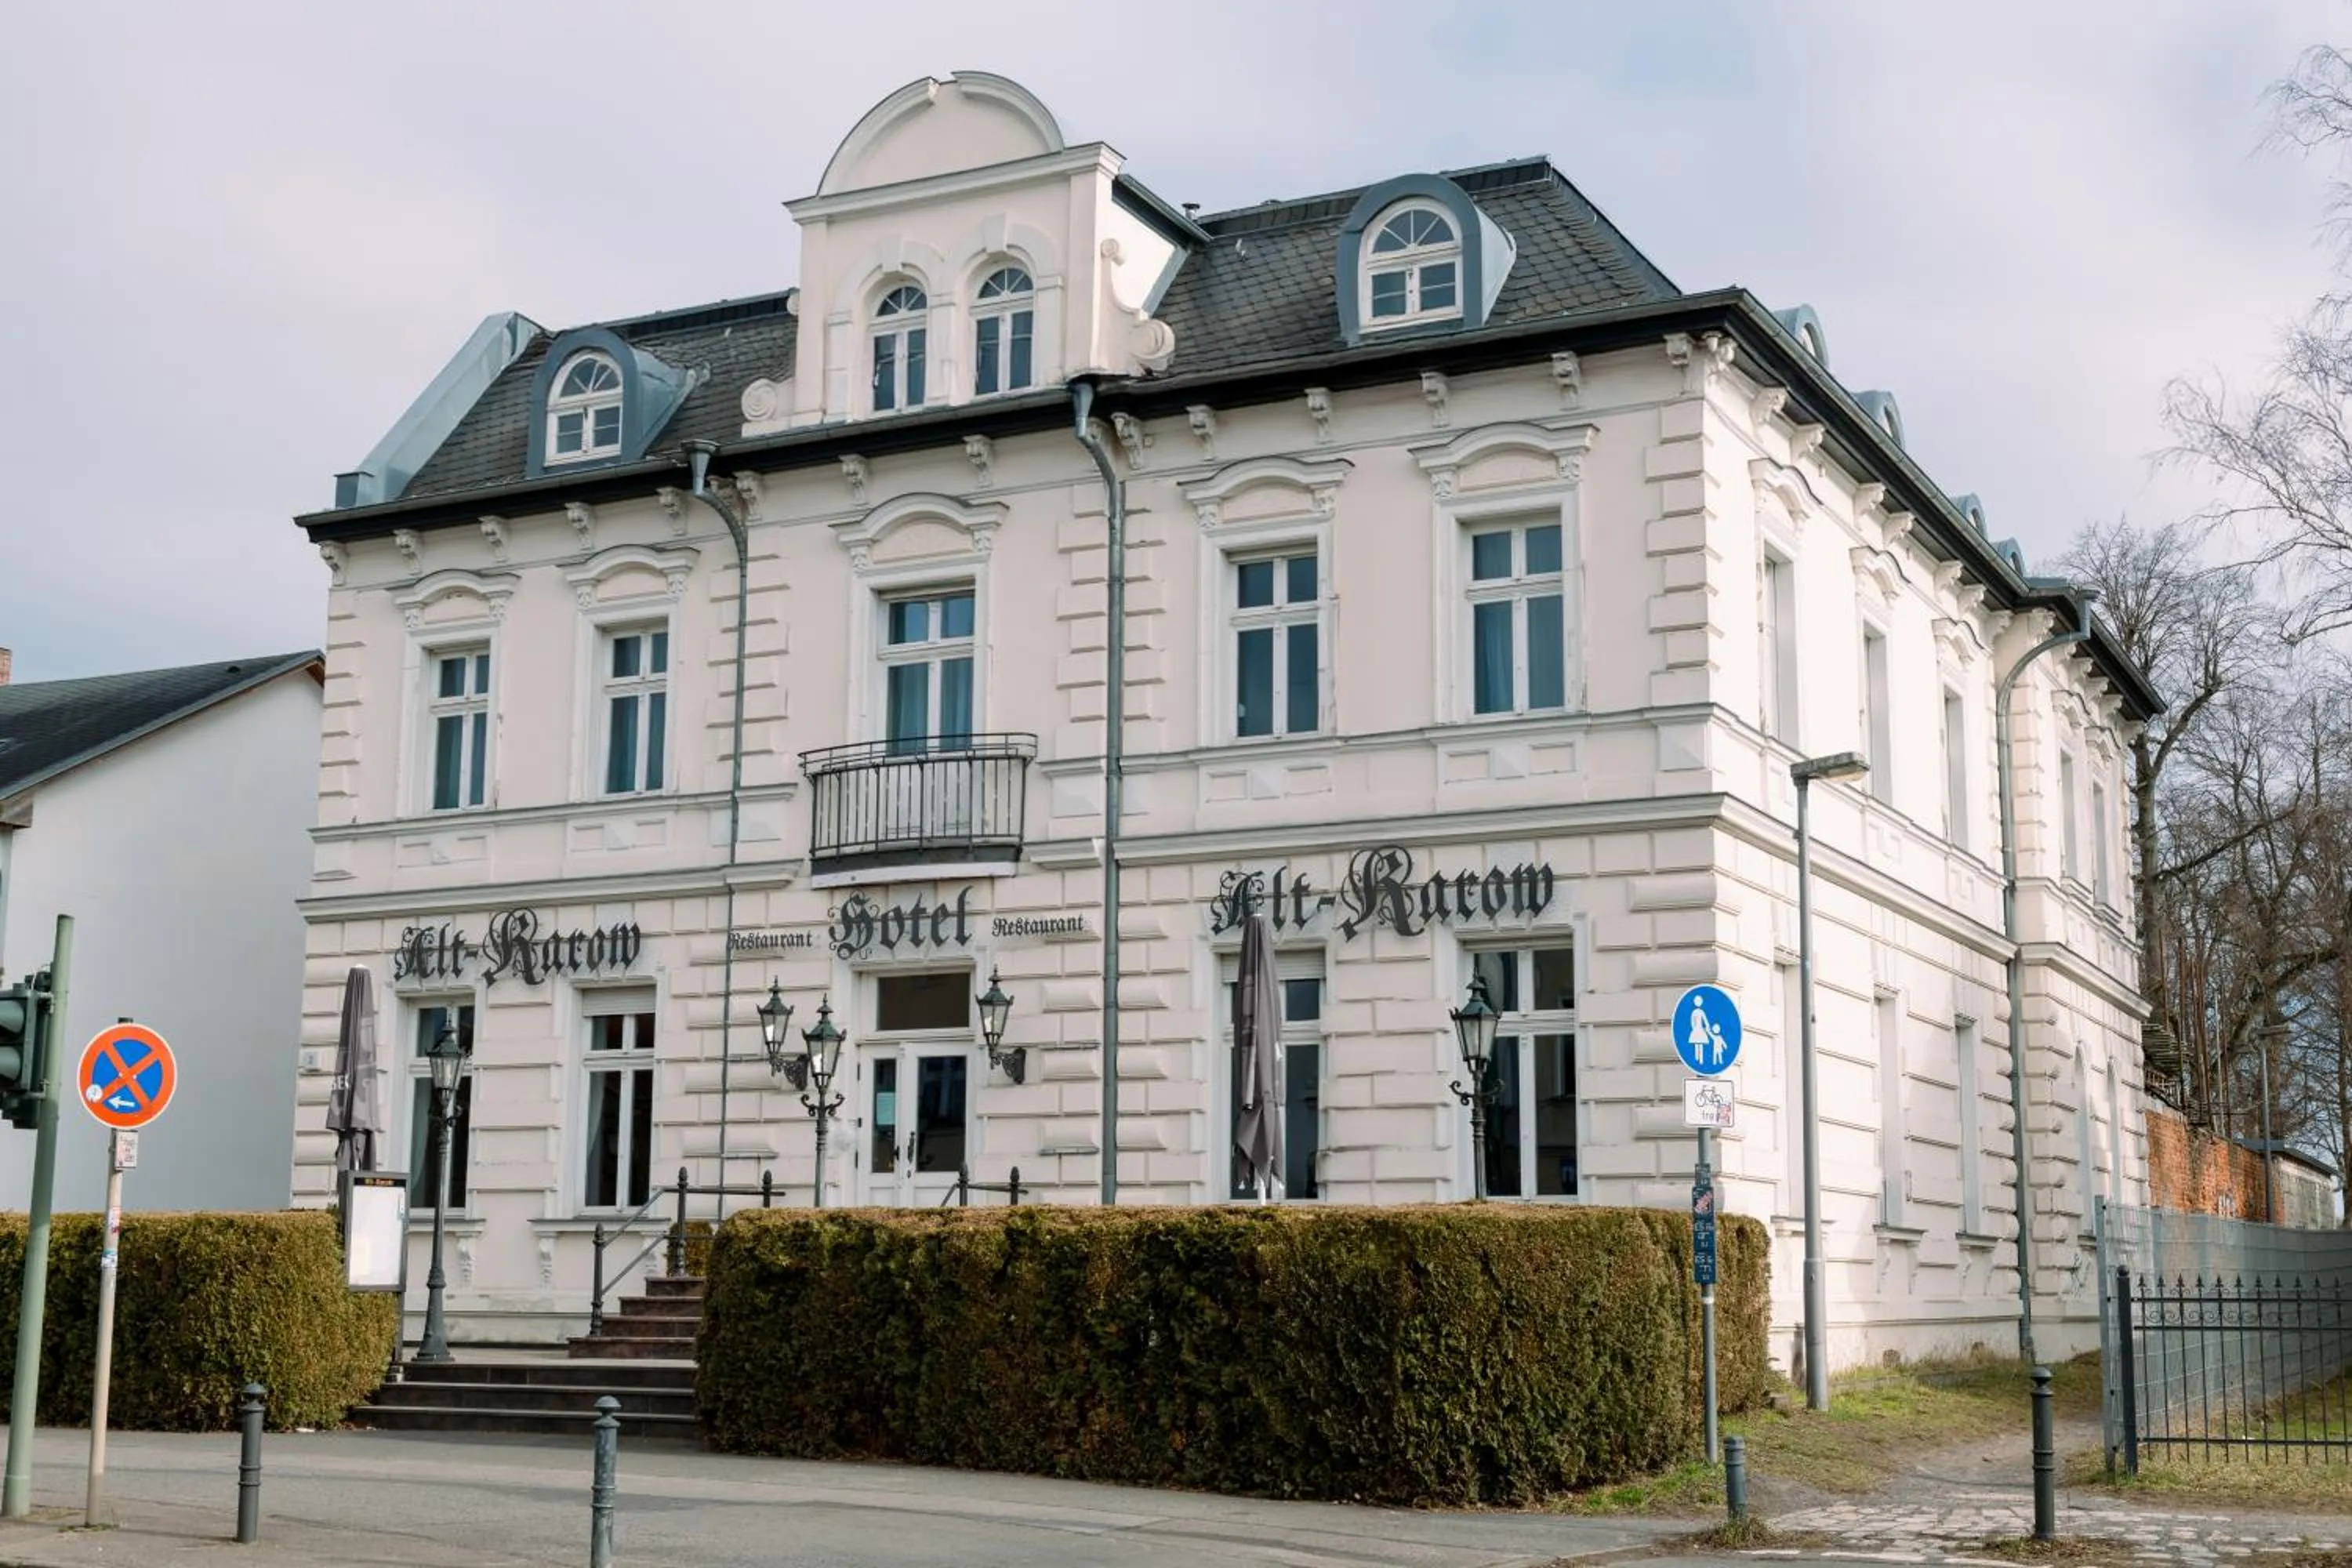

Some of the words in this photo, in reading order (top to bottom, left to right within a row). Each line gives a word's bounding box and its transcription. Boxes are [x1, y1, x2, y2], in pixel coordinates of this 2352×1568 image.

[828, 885, 974, 960] Hotel
[992, 913, 1083, 937] Restaurant
[1210, 844, 1554, 942] Alt-Karow
[394, 907, 641, 988] Alt-Karow
[727, 929, 812, 950] Restaurant
